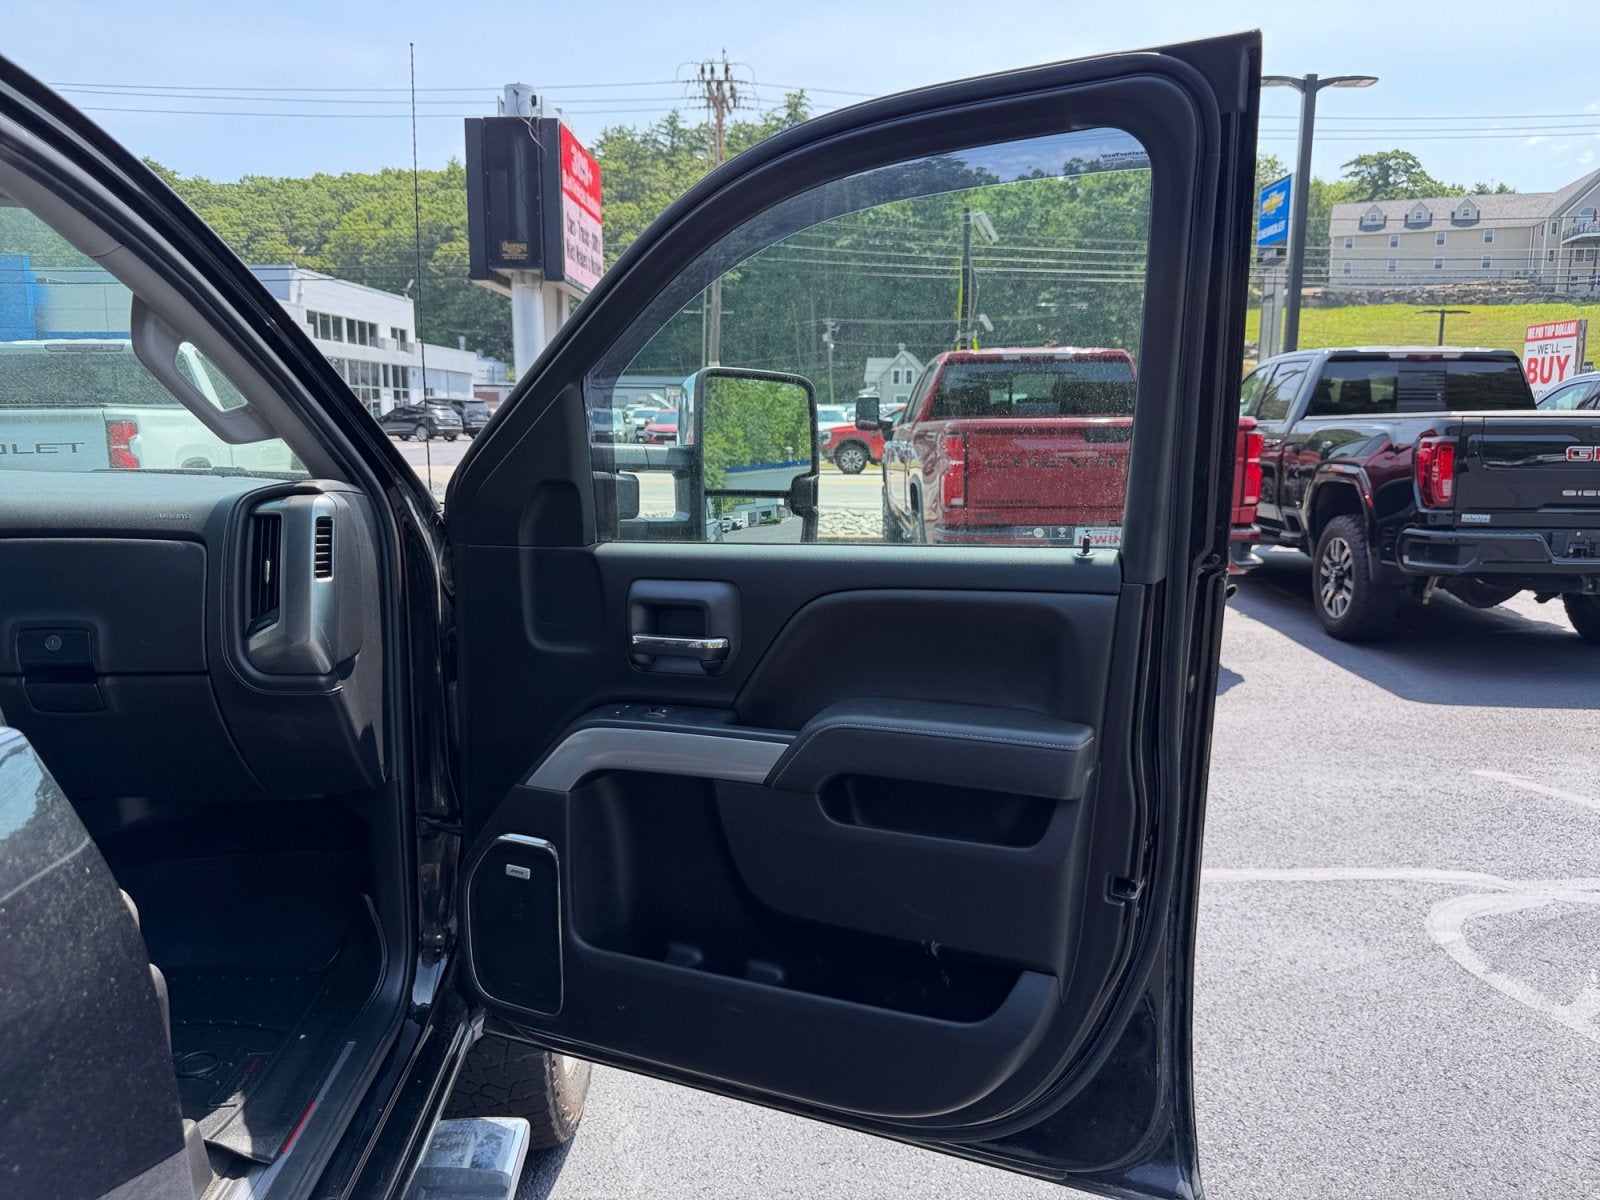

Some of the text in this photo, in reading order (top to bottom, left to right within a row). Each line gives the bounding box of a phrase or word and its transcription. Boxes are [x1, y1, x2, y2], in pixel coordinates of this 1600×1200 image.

[1537, 343, 1560, 354] WE'LL
[1526, 354, 1570, 384] BUY
[1565, 445, 1600, 462] G
